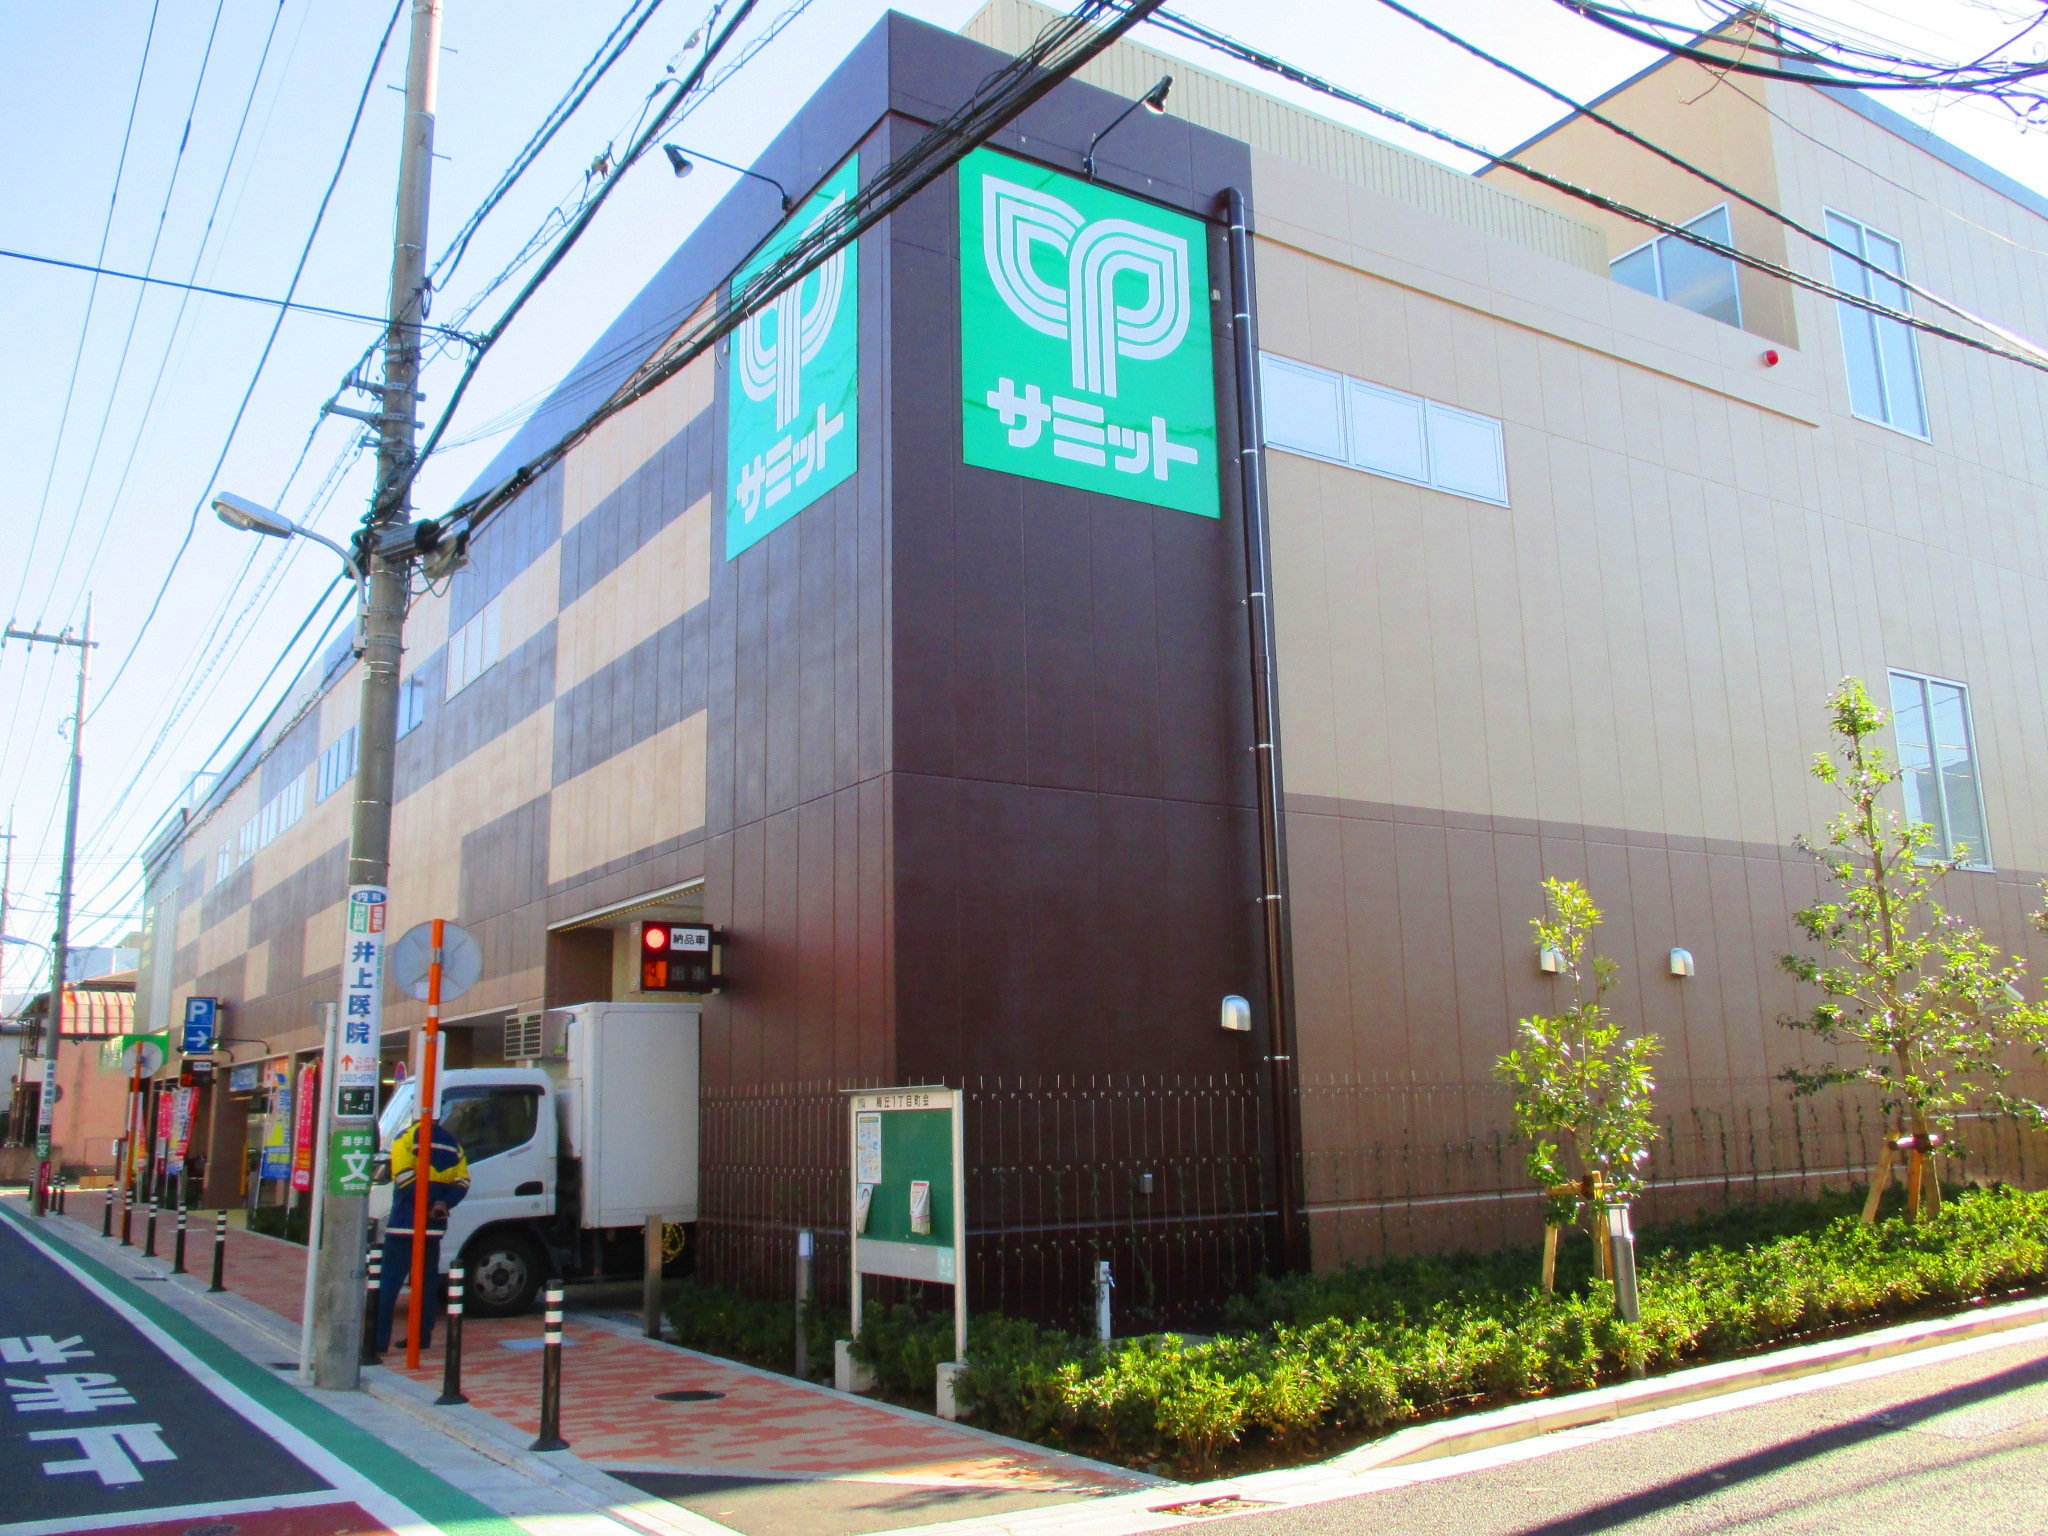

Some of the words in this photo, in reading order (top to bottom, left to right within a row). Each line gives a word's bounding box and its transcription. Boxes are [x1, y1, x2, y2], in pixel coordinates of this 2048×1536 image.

[987, 377, 1198, 481] サミット
[736, 402, 844, 524] サミット
[357, 891, 382, 902] 内科
[672, 933, 706, 946] 納品車
[346, 941, 376, 1045] 井上医院
[189, 1001, 208, 1022] P
[340, 1149, 371, 1183] 文
